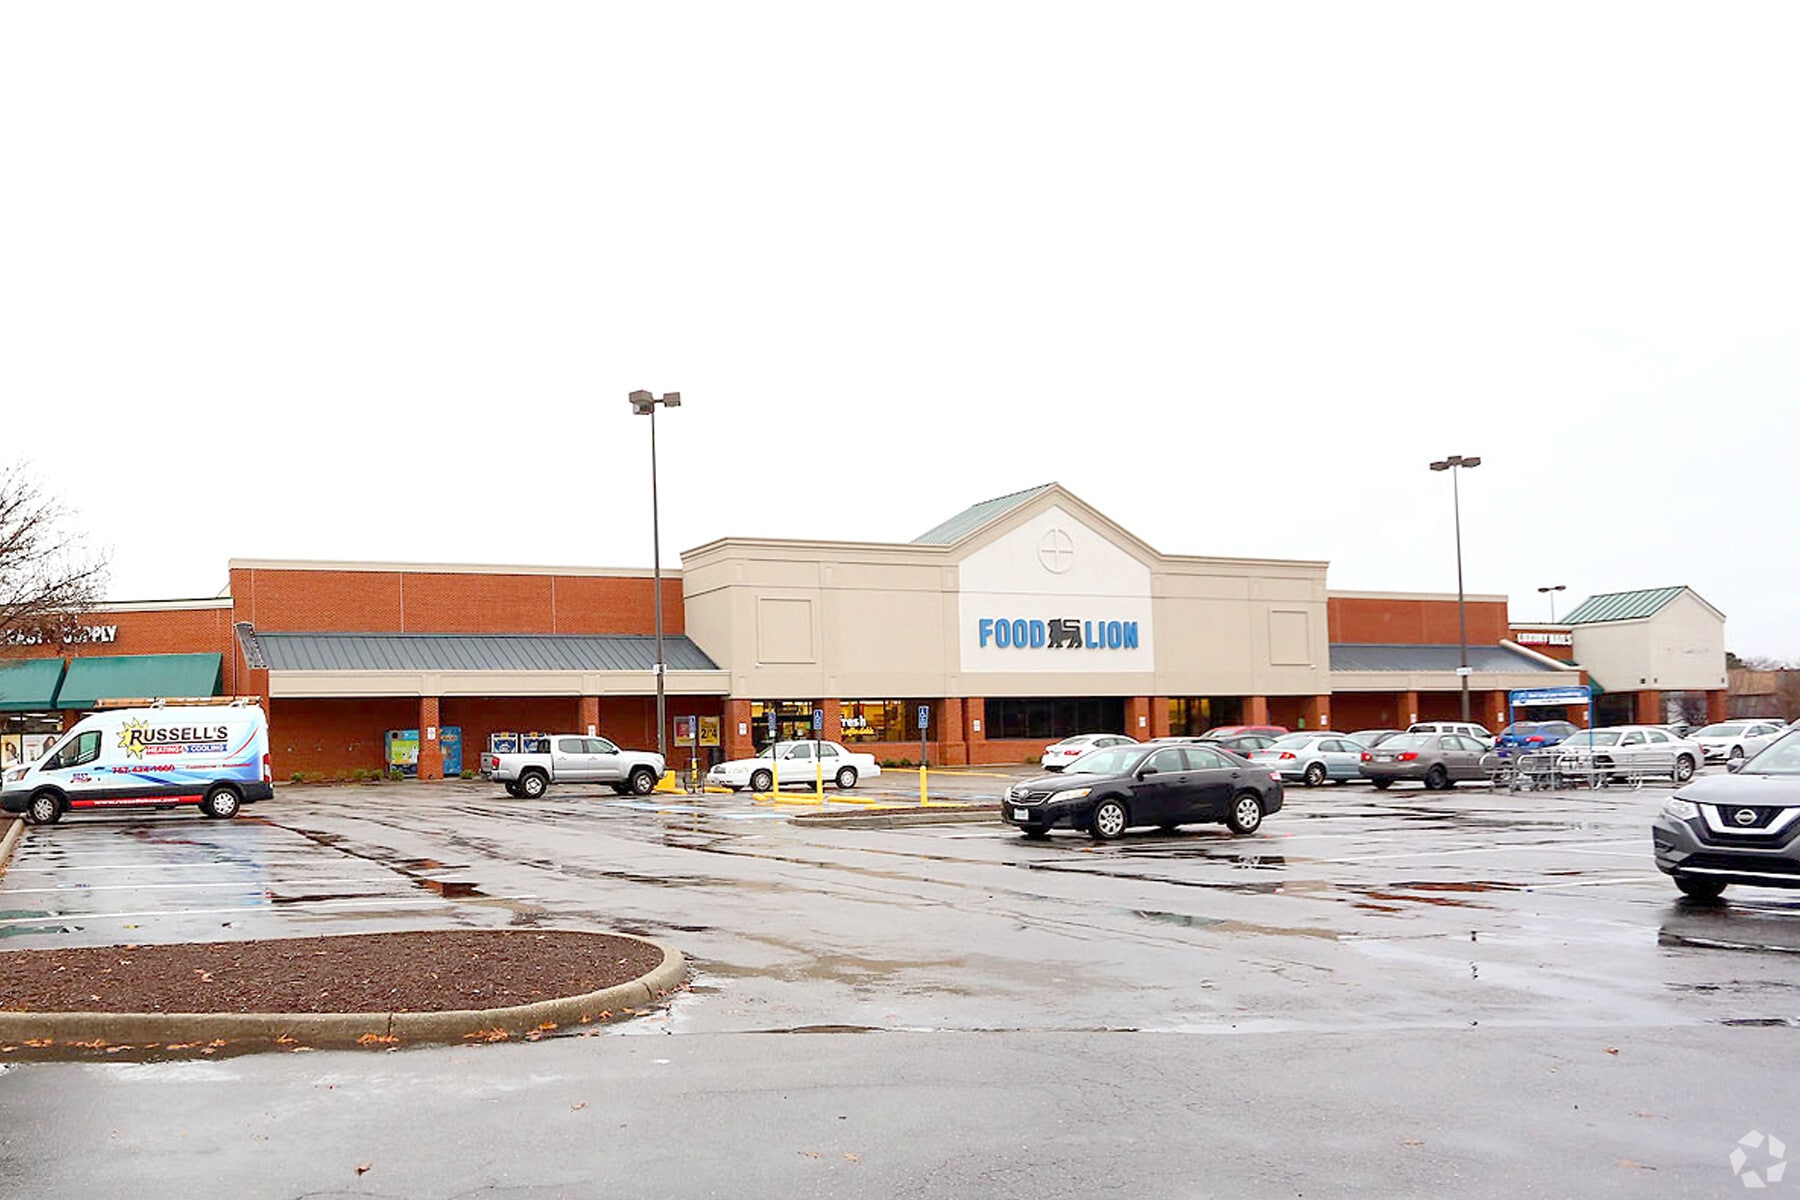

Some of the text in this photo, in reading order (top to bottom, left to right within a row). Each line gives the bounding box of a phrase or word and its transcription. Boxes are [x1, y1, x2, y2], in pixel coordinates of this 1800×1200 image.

[979, 617, 1139, 650] FOOD LION
[130, 725, 228, 746] RUSSELL'S
